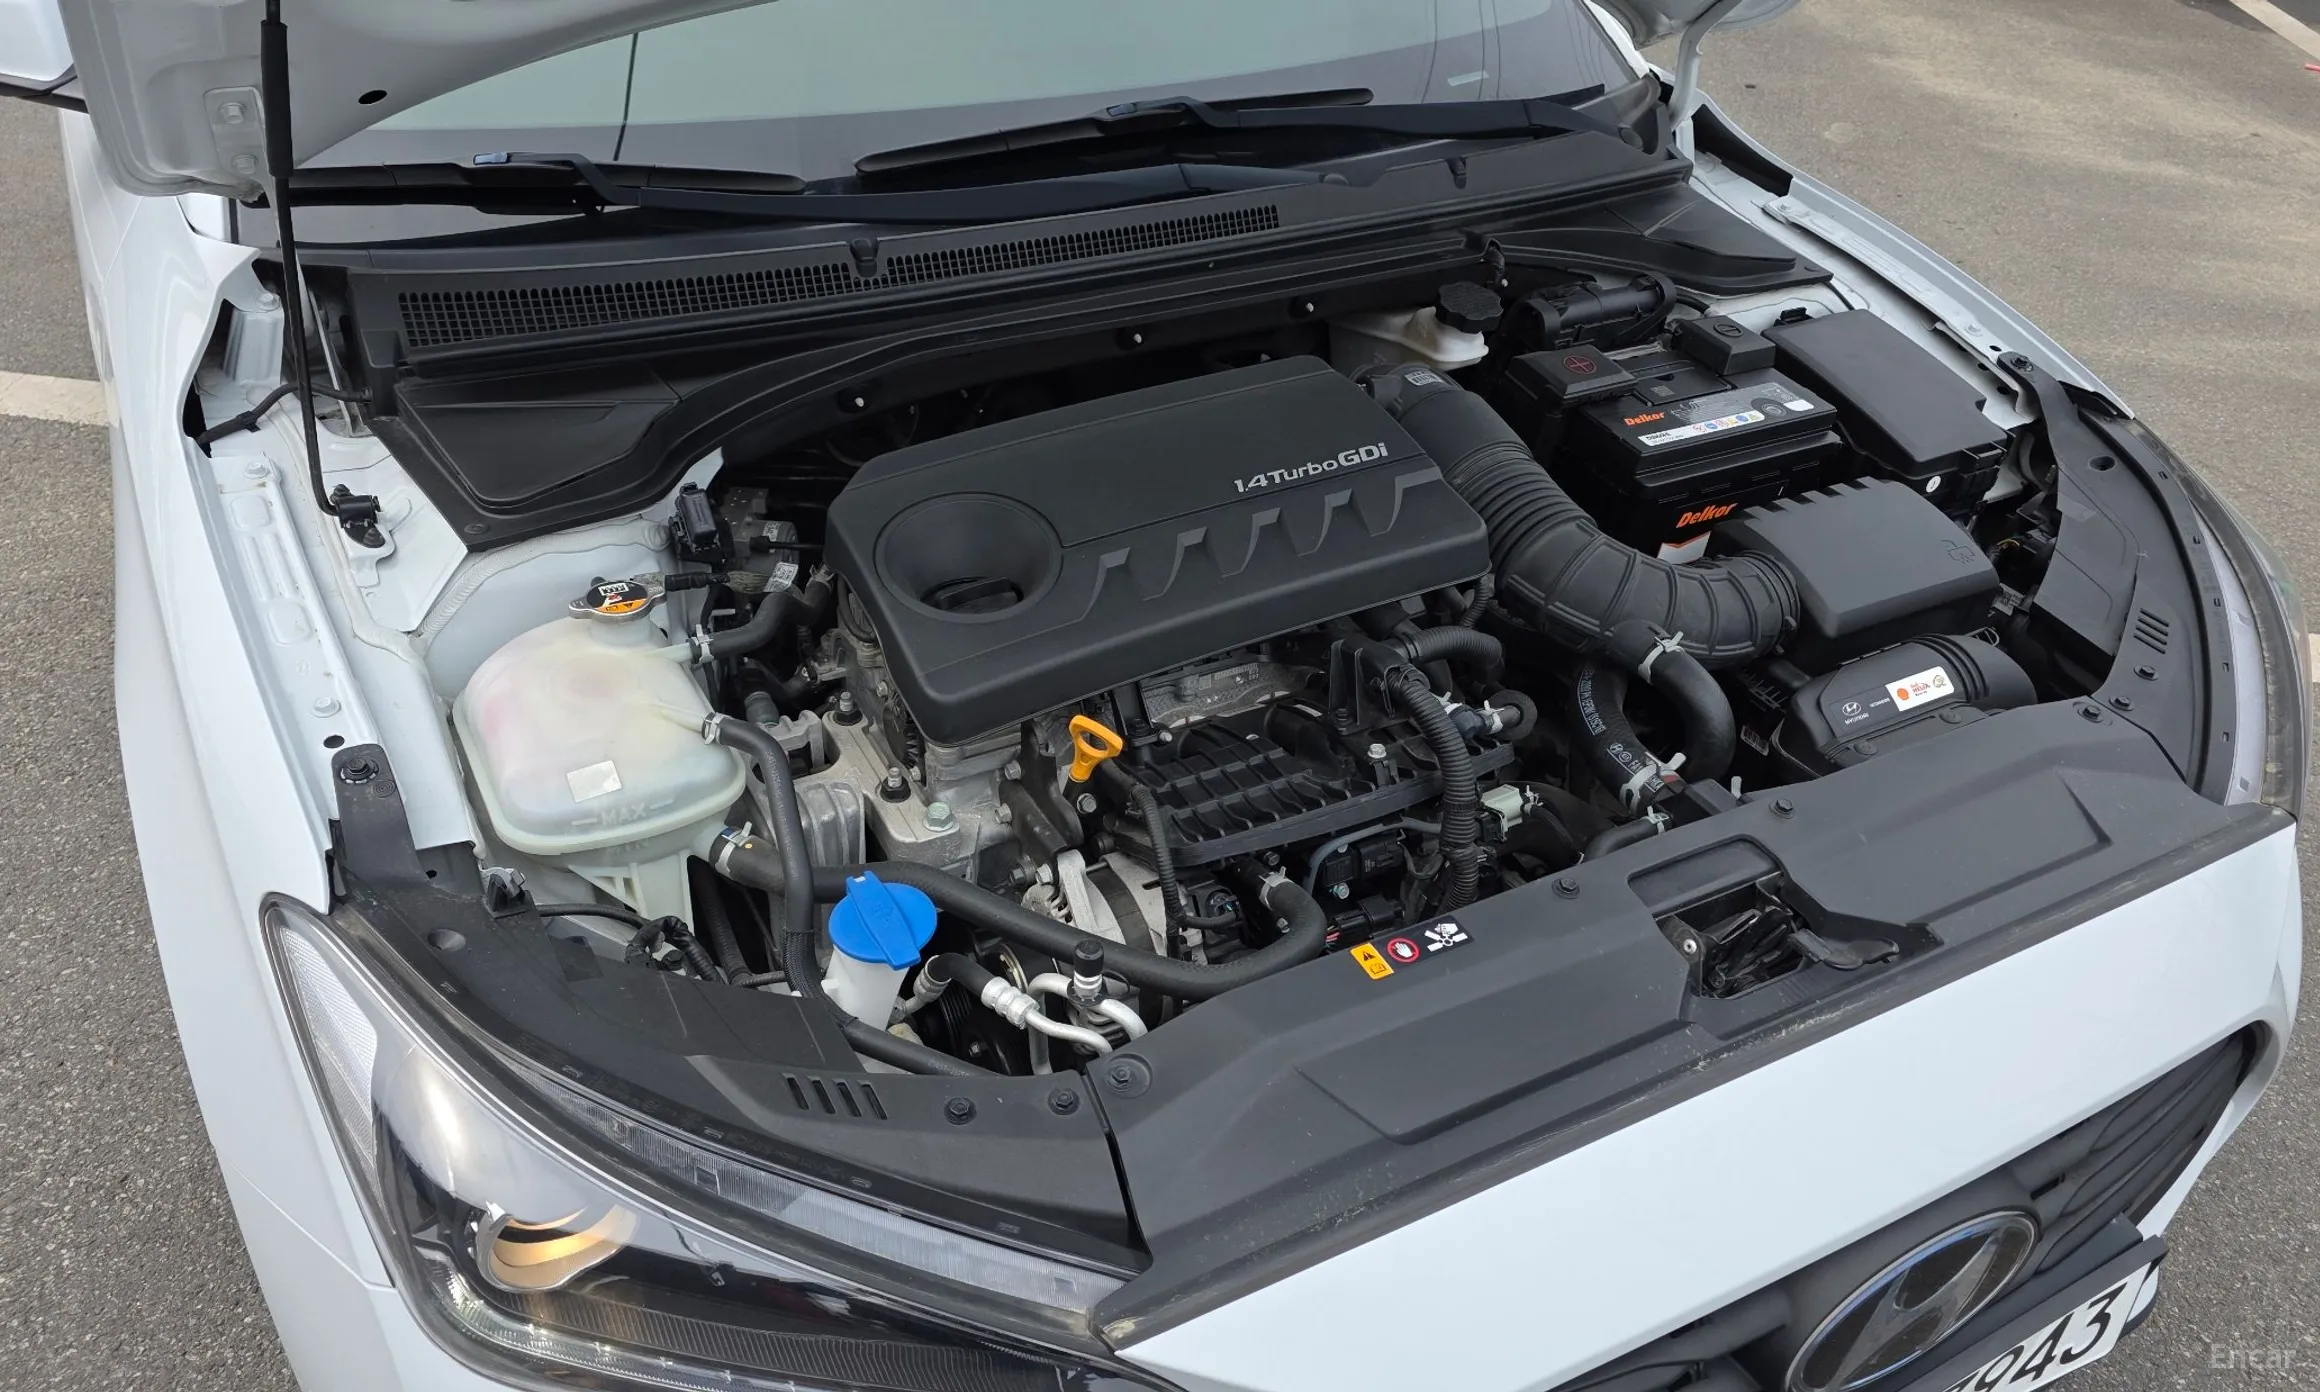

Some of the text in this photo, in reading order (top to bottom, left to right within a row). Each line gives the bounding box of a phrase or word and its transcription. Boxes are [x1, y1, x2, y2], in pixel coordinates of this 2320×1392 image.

[1624, 410, 1665, 426] Delkor
[1676, 502, 1738, 528] Delkor
[601, 802, 647, 826] MAX
